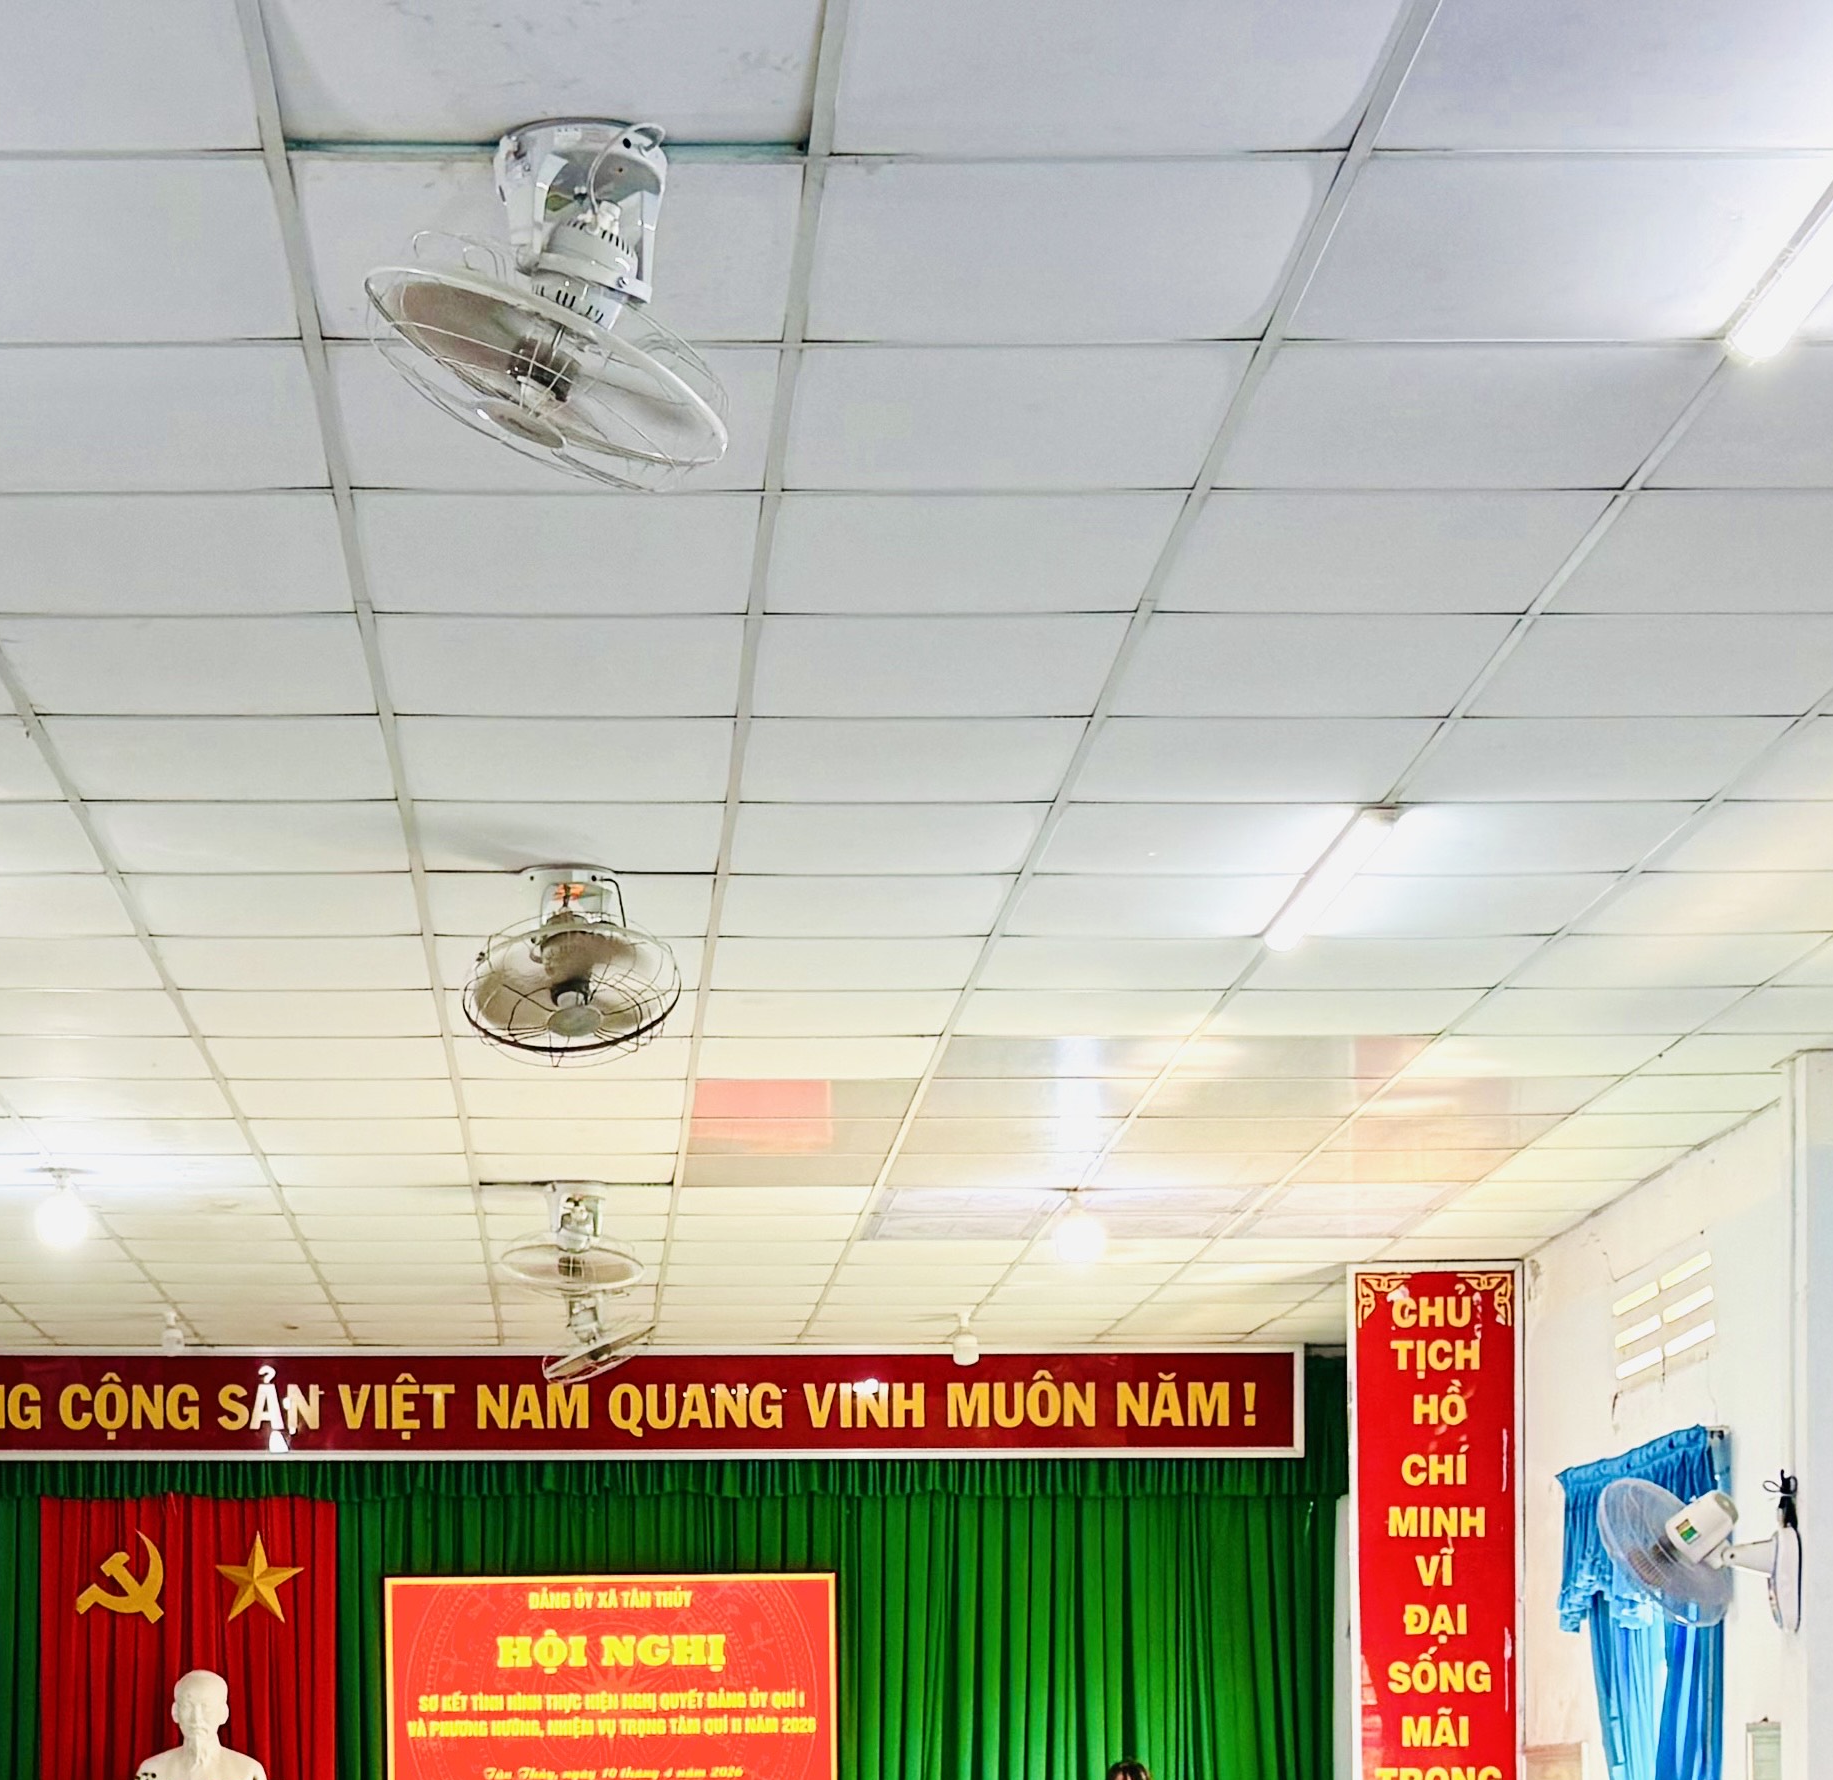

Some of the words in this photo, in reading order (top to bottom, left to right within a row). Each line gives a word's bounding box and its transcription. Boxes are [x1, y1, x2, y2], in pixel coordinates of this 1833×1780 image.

[1391, 1283, 1473, 1328] CHỦ
[1390, 1339, 1481, 1380] TỊCH
[58, 1372, 200, 1440] CỘNG
[217, 1366, 320, 1430] SẢN
[338, 1372, 455, 1440] VIỆT
[477, 1383, 590, 1429] NAM
[608, 1382, 785, 1438] QUANG
[802, 1381, 926, 1429] VINH
[947, 1369, 1097, 1429] MUÔN
[1116, 1371, 1230, 1428] NĂM
[1243, 1382, 1257, 1427] !
[1413, 1379, 1468, 1426] HỒ
[1401, 1444, 1470, 1486] CHÍ
[1387, 1506, 1486, 1538] MINH
[1415, 1547, 1455, 1587] VĨ
[528, 1587, 571, 1609] ĐẢNG
[621, 1587, 652, 1608] TÂN
[1403, 1604, 1468, 1644] ĐẠI
[496, 1628, 588, 1674] HỘI
[601, 1634, 727, 1672] NGHỊ
[1388, 1646, 1492, 1694] SỐNG
[1401, 1707, 1470, 1747] MÃI
